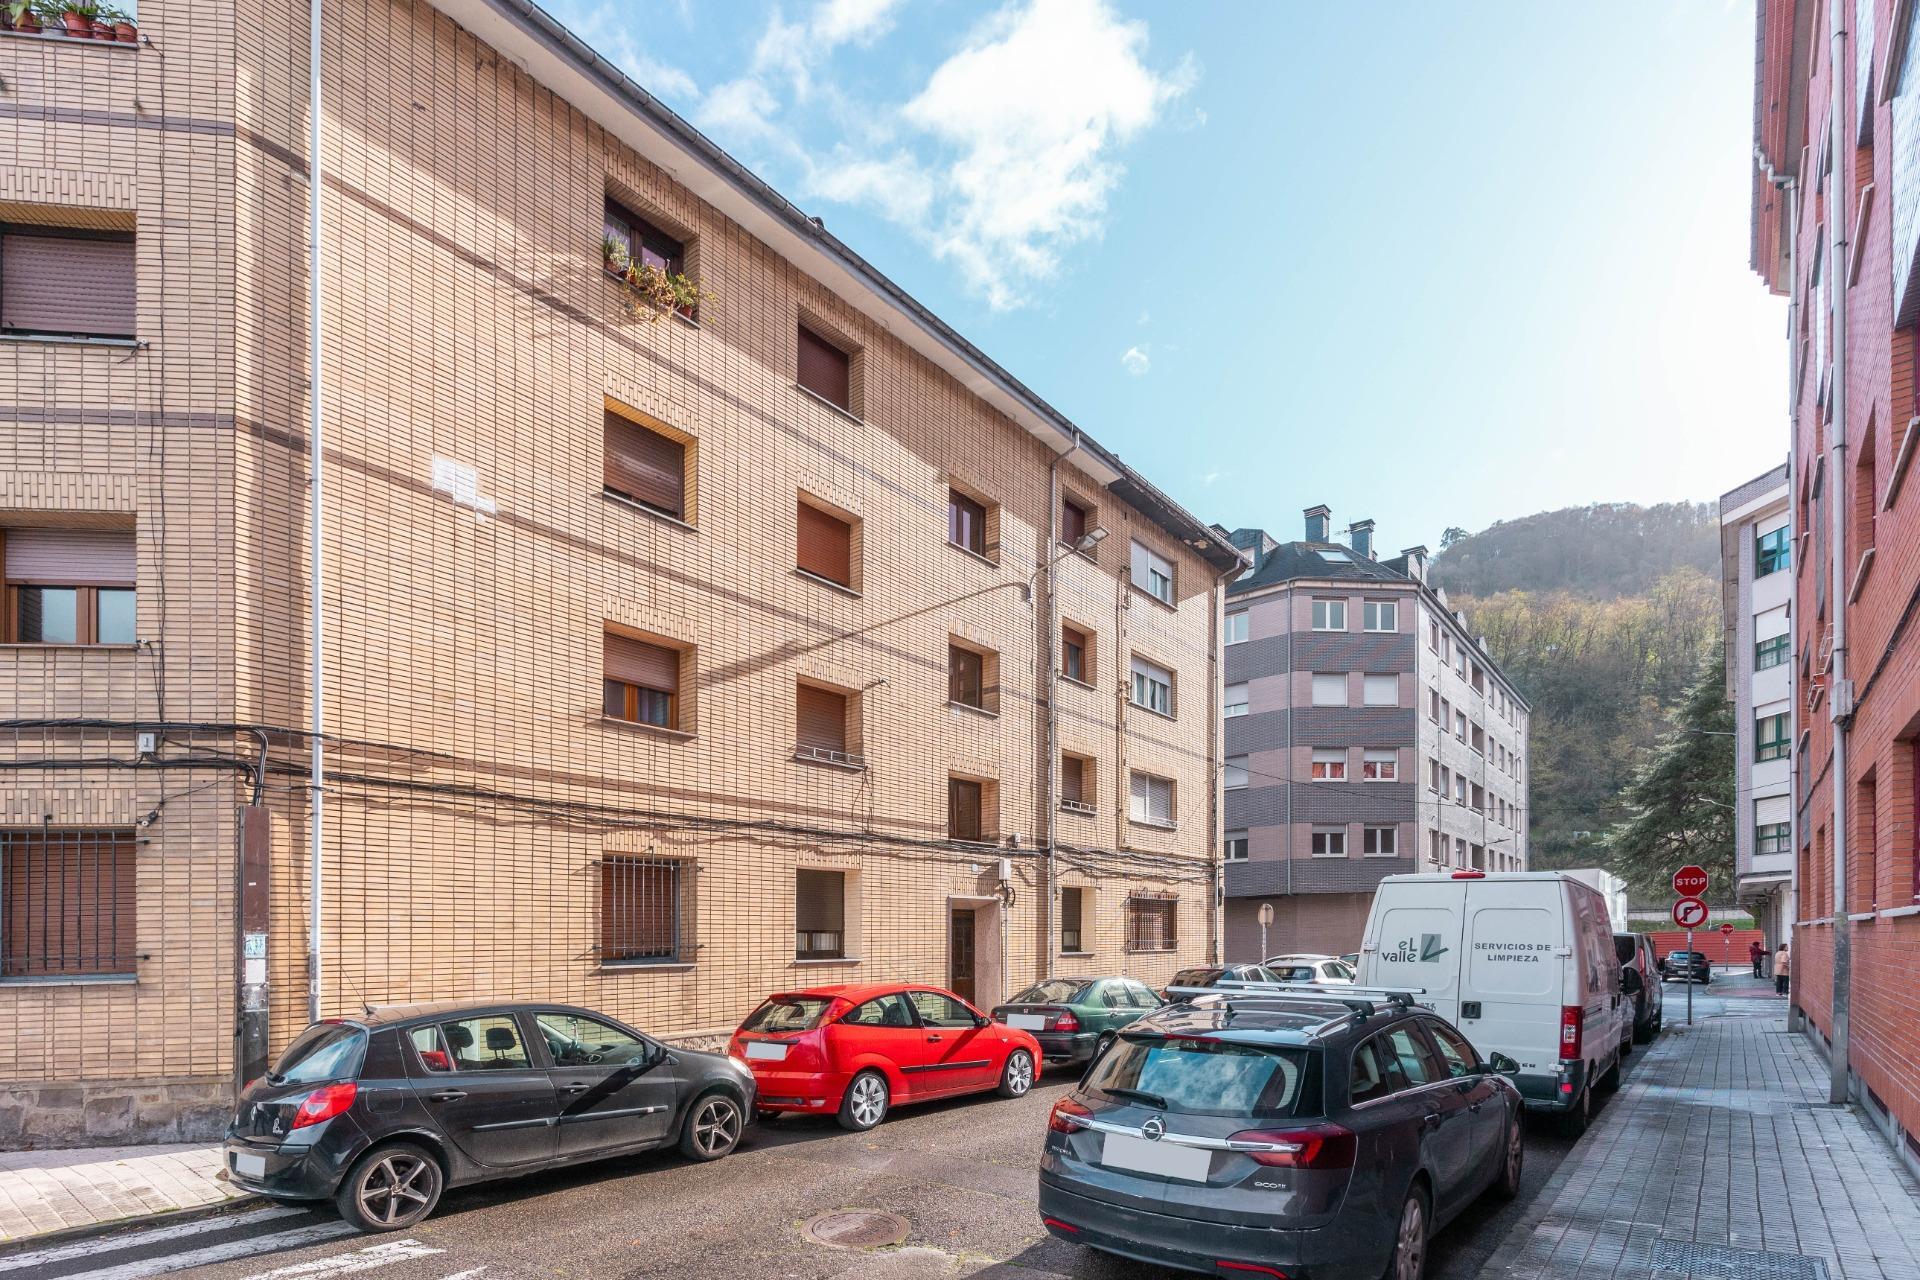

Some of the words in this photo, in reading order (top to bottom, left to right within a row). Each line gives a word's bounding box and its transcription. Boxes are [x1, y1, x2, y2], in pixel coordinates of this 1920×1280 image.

[1676, 877, 1706, 886] STOP
[1474, 942, 1534, 951] SERVICIOS
[1381, 950, 1417, 963] valle
[1487, 954, 1539, 963] LIMPIEZA
